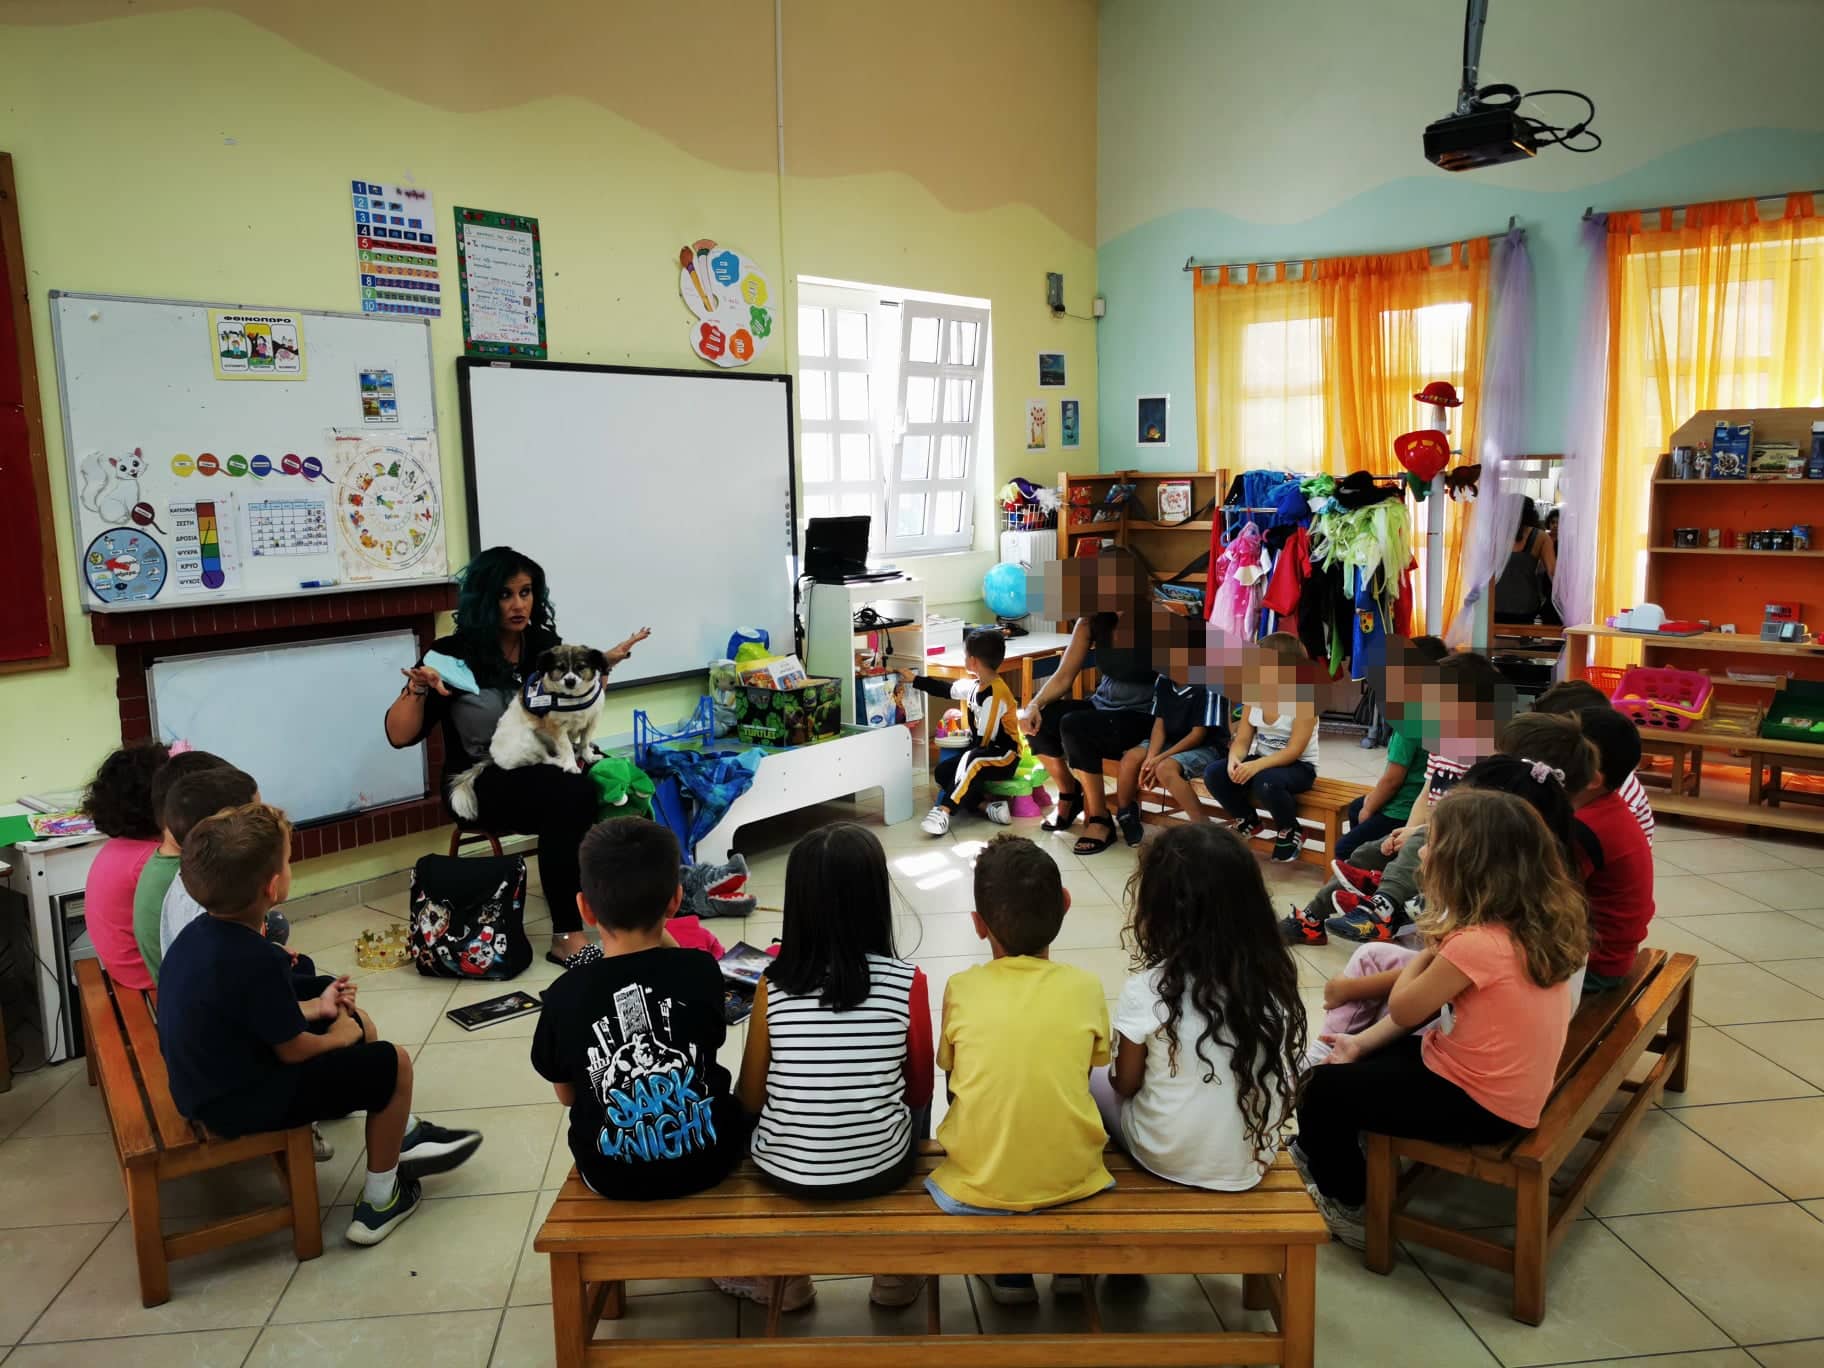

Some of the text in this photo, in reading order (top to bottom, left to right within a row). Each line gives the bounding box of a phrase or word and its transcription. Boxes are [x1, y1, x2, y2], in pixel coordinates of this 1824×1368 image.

[358, 183, 363, 193] 1
[358, 199, 365, 208] 2
[360, 213, 366, 223] 3
[361, 226, 368, 235] 4
[361, 238, 369, 248] 5
[362, 251, 369, 261] 6
[364, 263, 369, 273] 7
[366, 276, 372, 286] 8
[365, 289, 372, 298] 9
[364, 301, 375, 311] 10
[608, 1066, 701, 1128] DARK
[599, 1096, 718, 1164] KNIGHT
